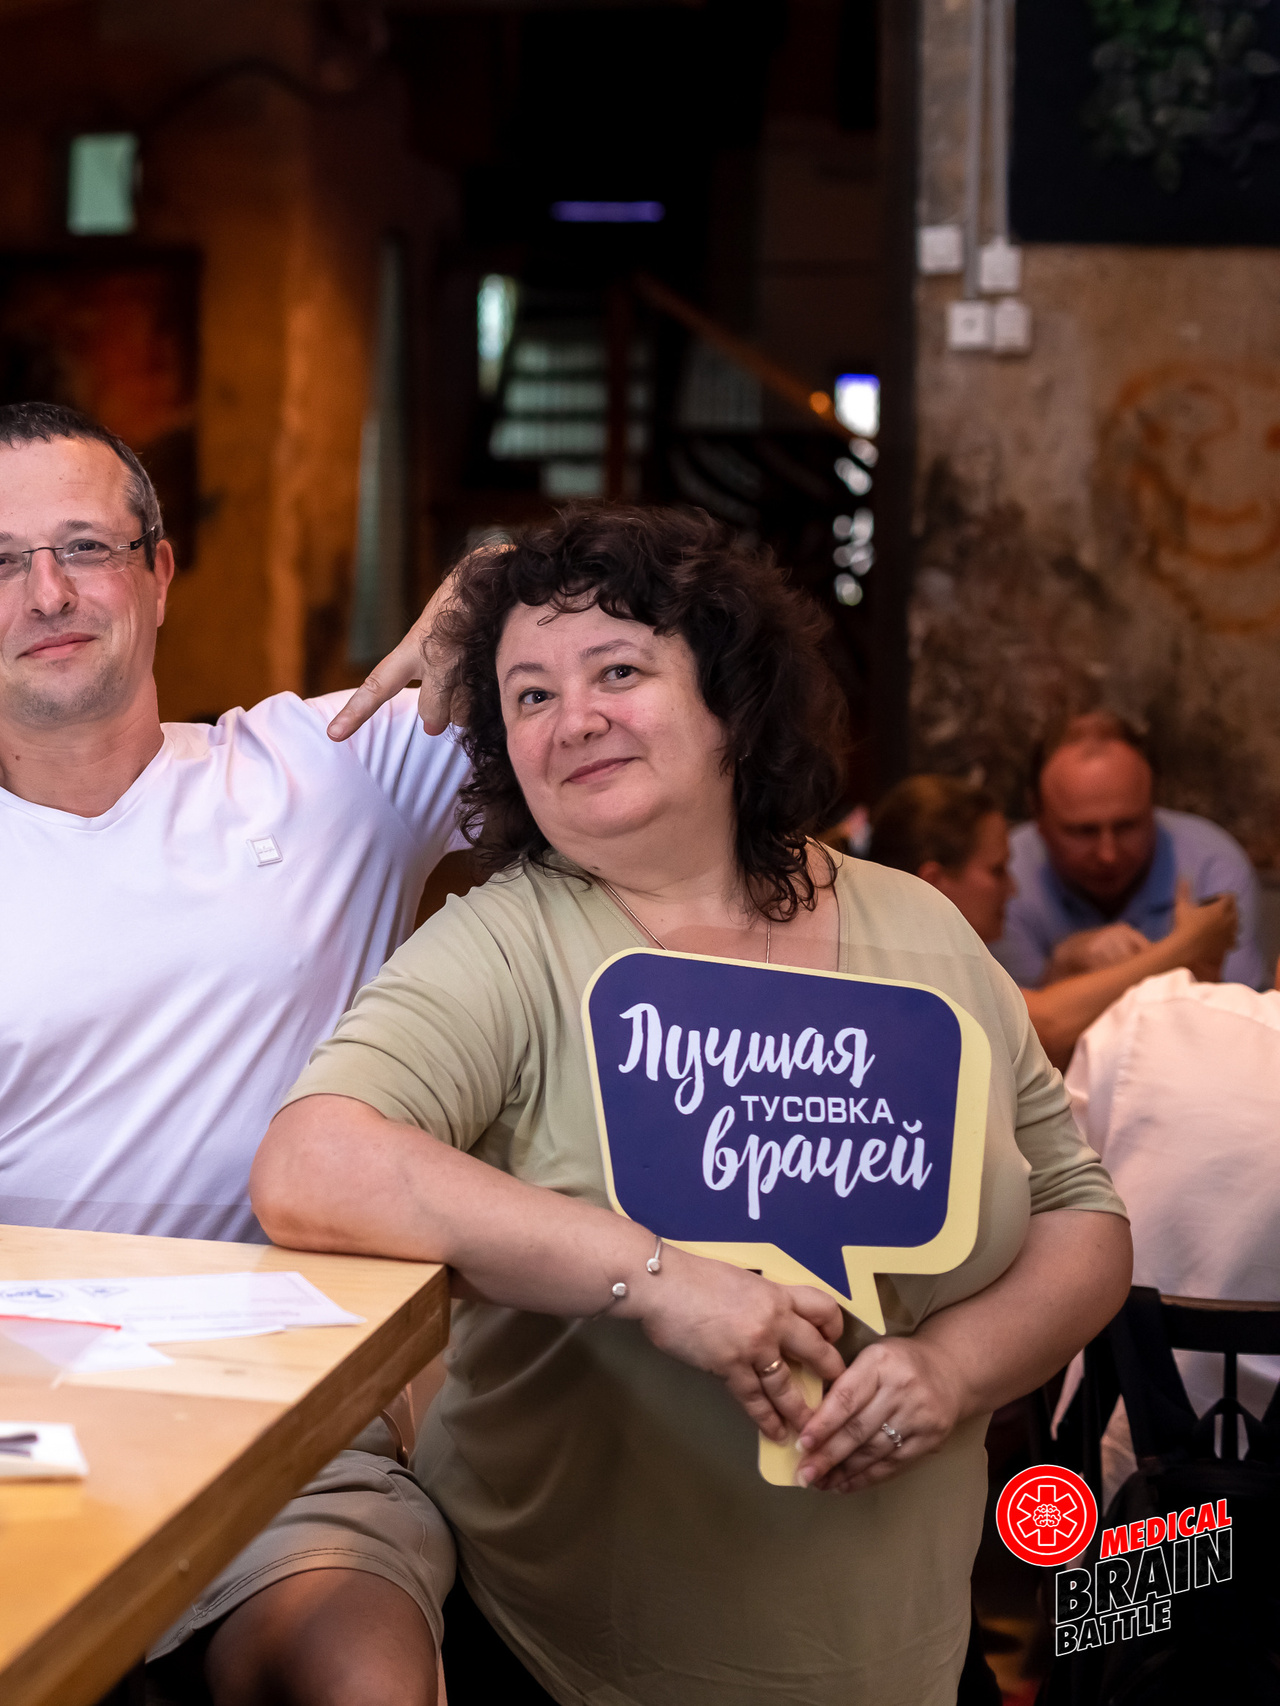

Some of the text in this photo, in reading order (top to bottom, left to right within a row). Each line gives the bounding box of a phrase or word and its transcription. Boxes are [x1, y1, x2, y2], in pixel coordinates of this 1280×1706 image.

[618, 1003, 875, 1115] Лучшая
[740, 1095, 895, 1125] ТУСОВКА
[702, 1105, 932, 1220] врачей
